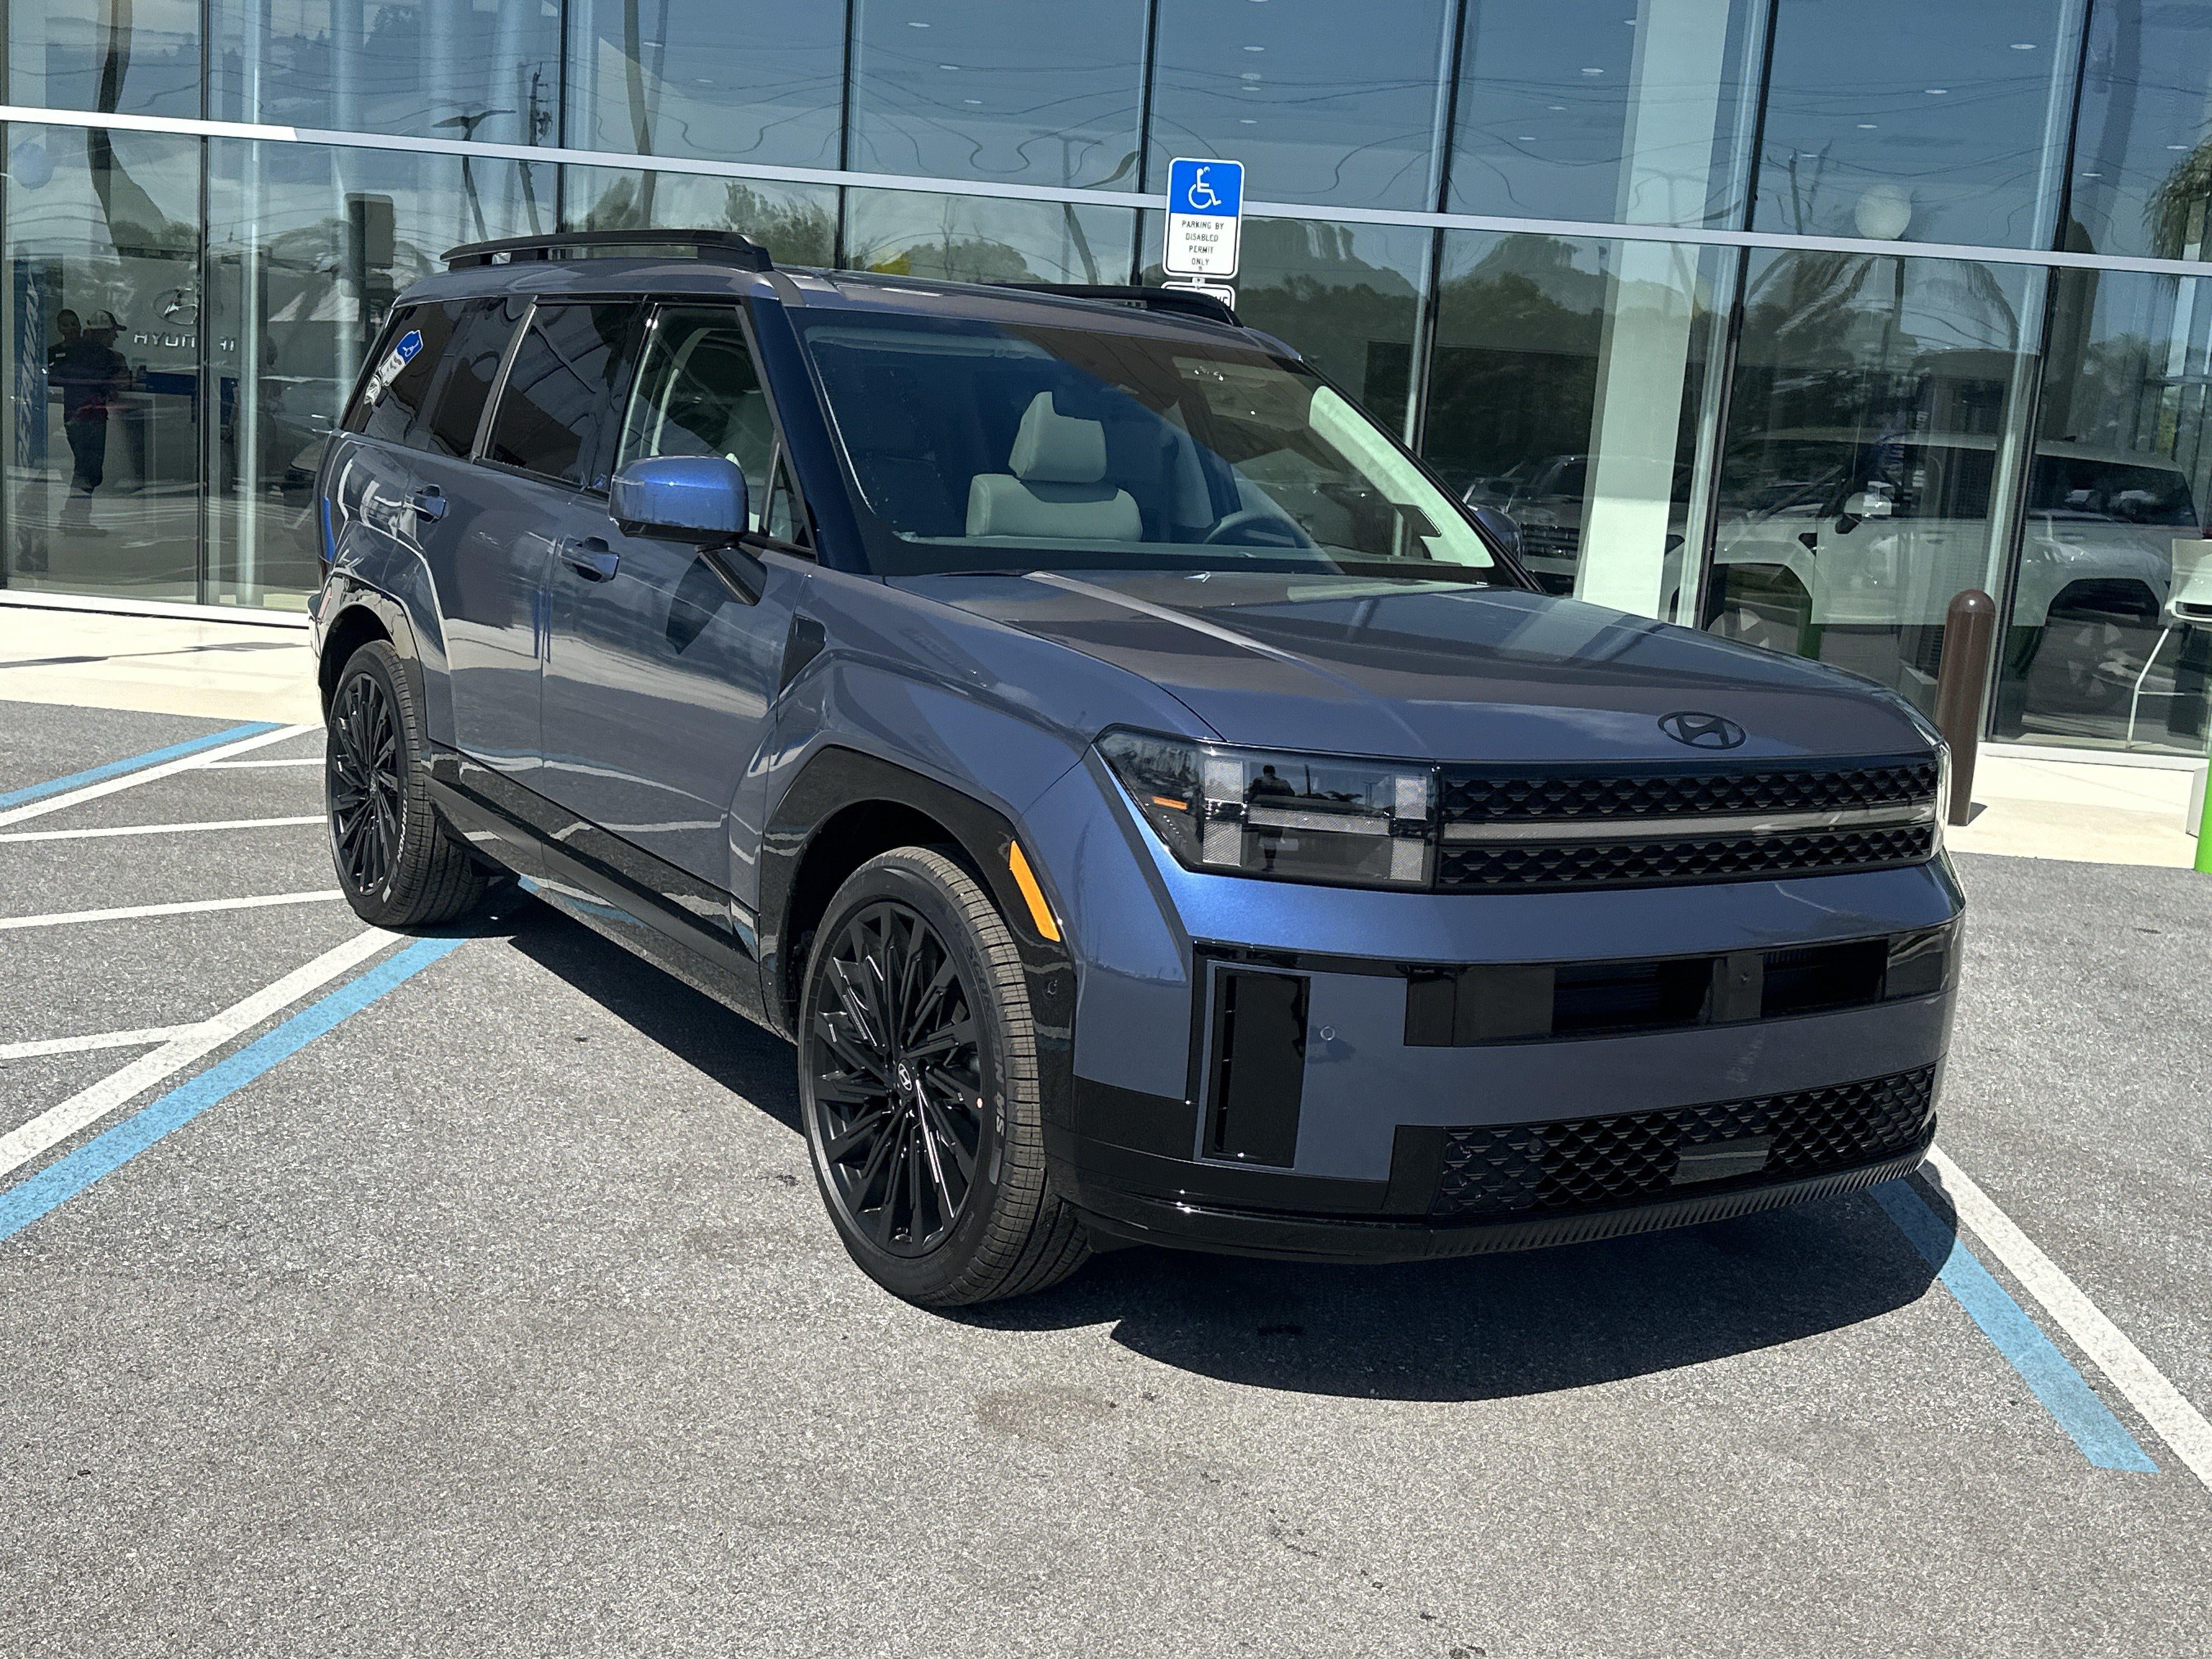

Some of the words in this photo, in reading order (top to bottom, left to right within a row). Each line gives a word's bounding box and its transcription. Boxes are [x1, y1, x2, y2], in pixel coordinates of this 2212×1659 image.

[1182, 220, 1211, 229] PARKING
[1215, 222, 1224, 230] BY
[1186, 233, 1218, 242] DISABLED
[1189, 245, 1214, 254] PERMIT
[1192, 257, 1209, 266] ONLY
[134, 332, 235, 351] HYUNAI
